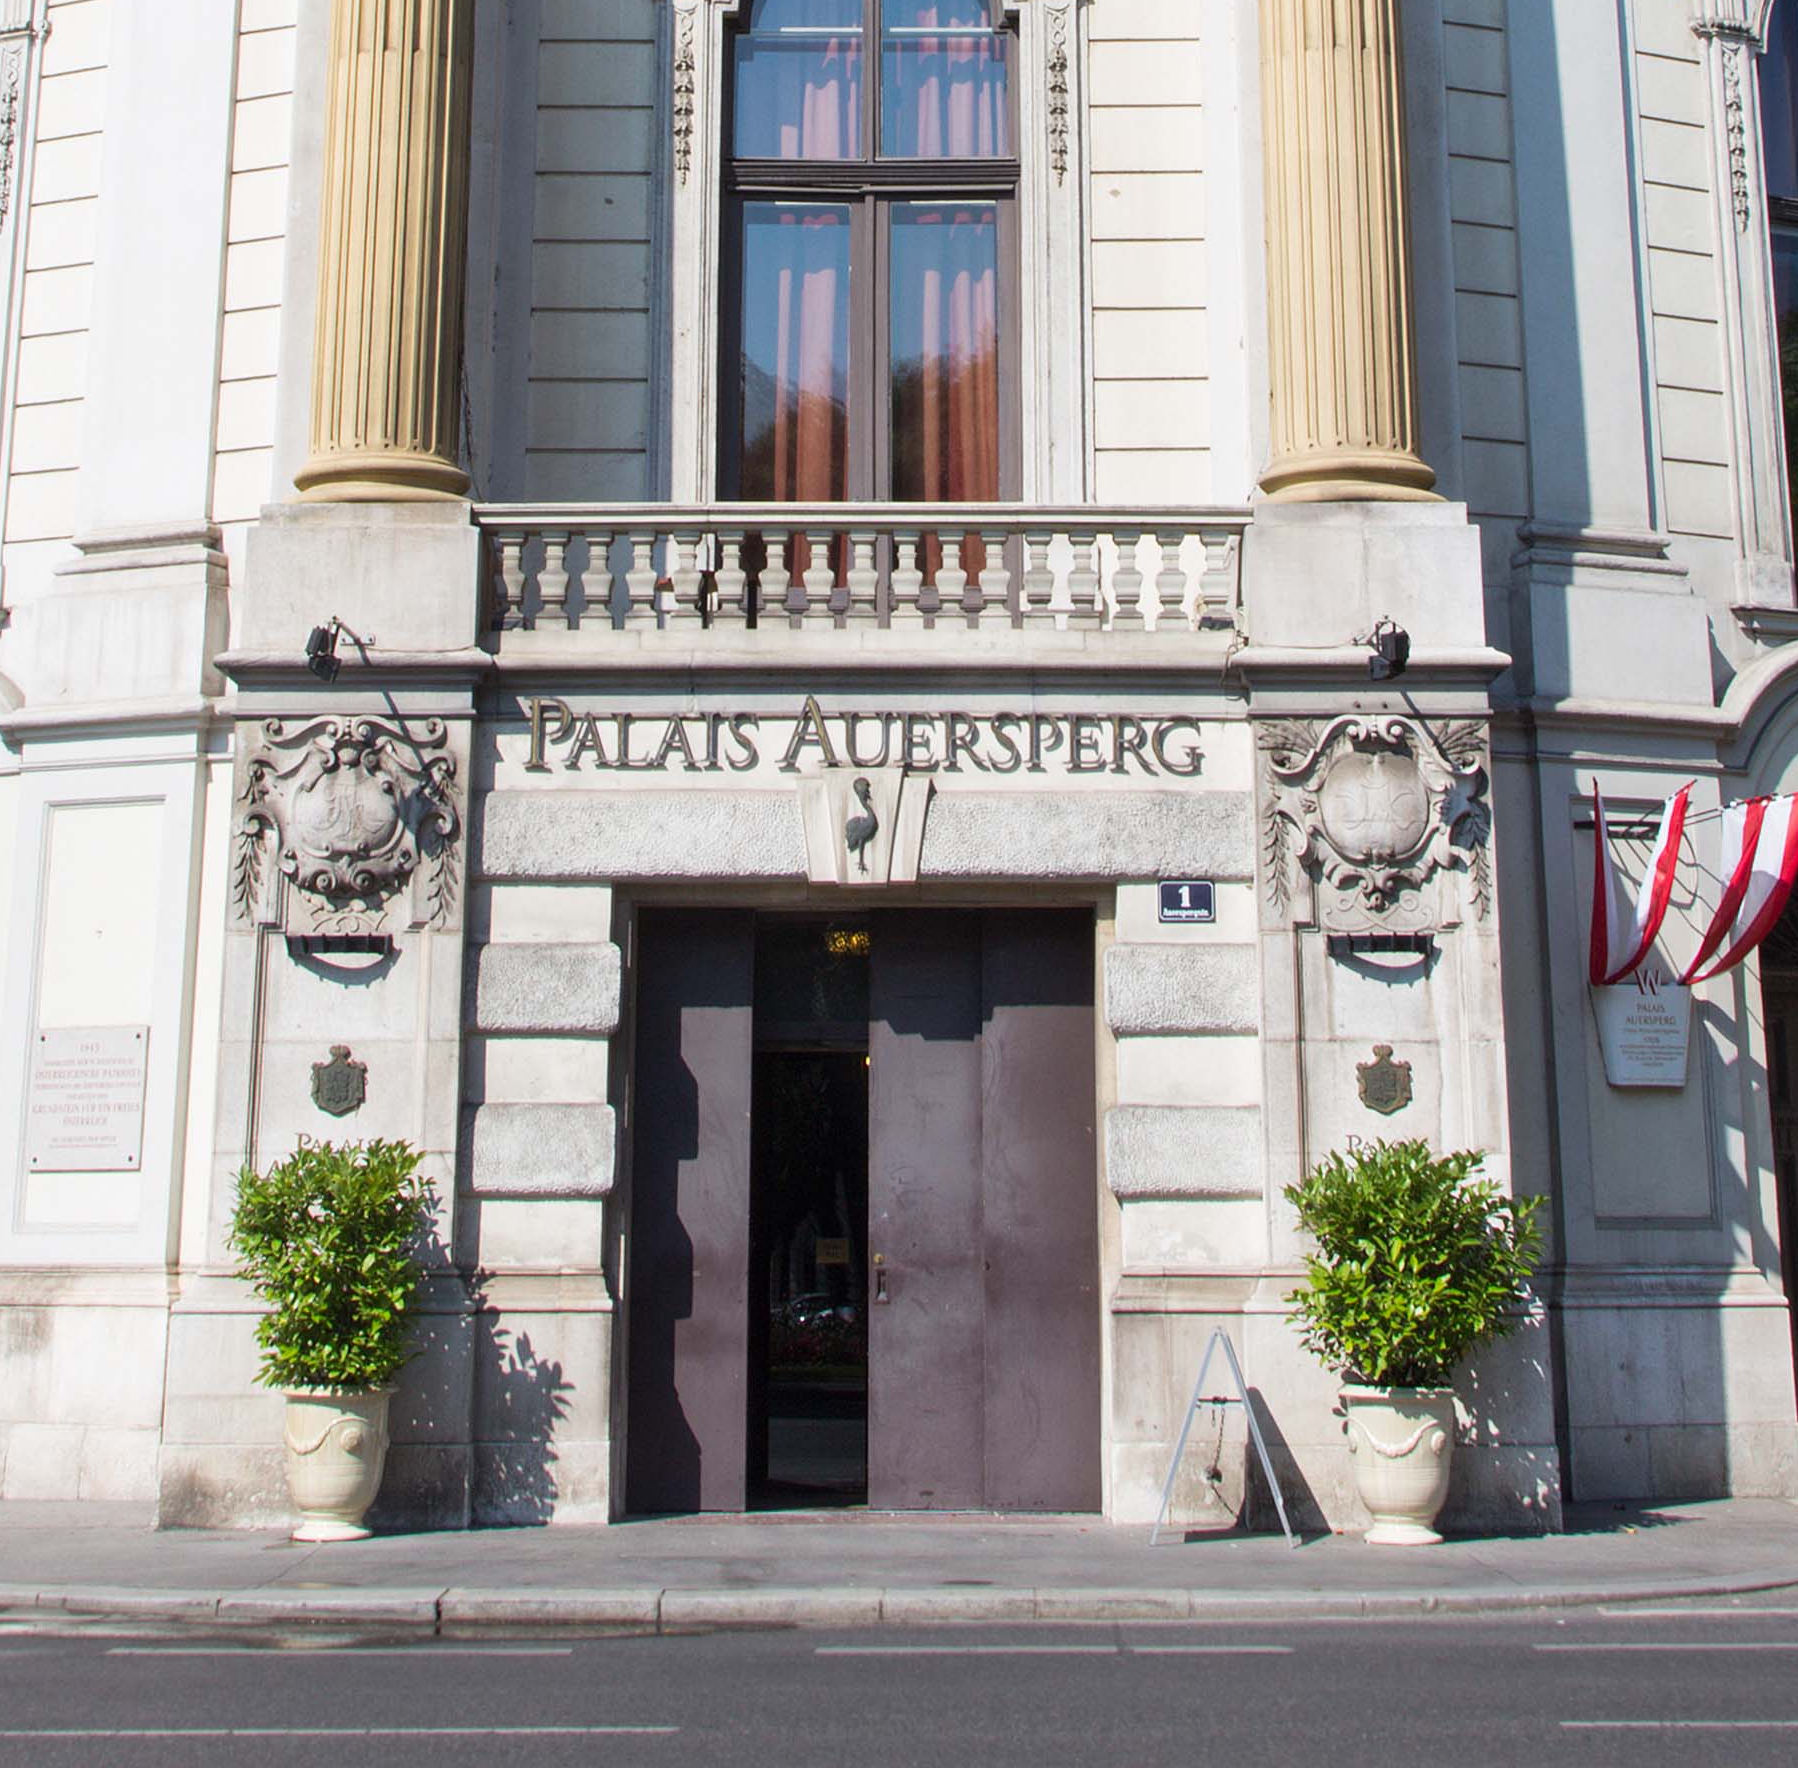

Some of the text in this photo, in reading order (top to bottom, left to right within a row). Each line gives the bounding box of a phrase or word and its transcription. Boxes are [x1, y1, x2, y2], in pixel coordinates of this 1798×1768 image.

[522, 694, 1206, 775] PALAIS AUERSPERG
[1178, 885, 1191, 907] 1
[1636, 1003, 1666, 1013] PALAIS
[1625, 1015, 1677, 1025] AUERSPERG
